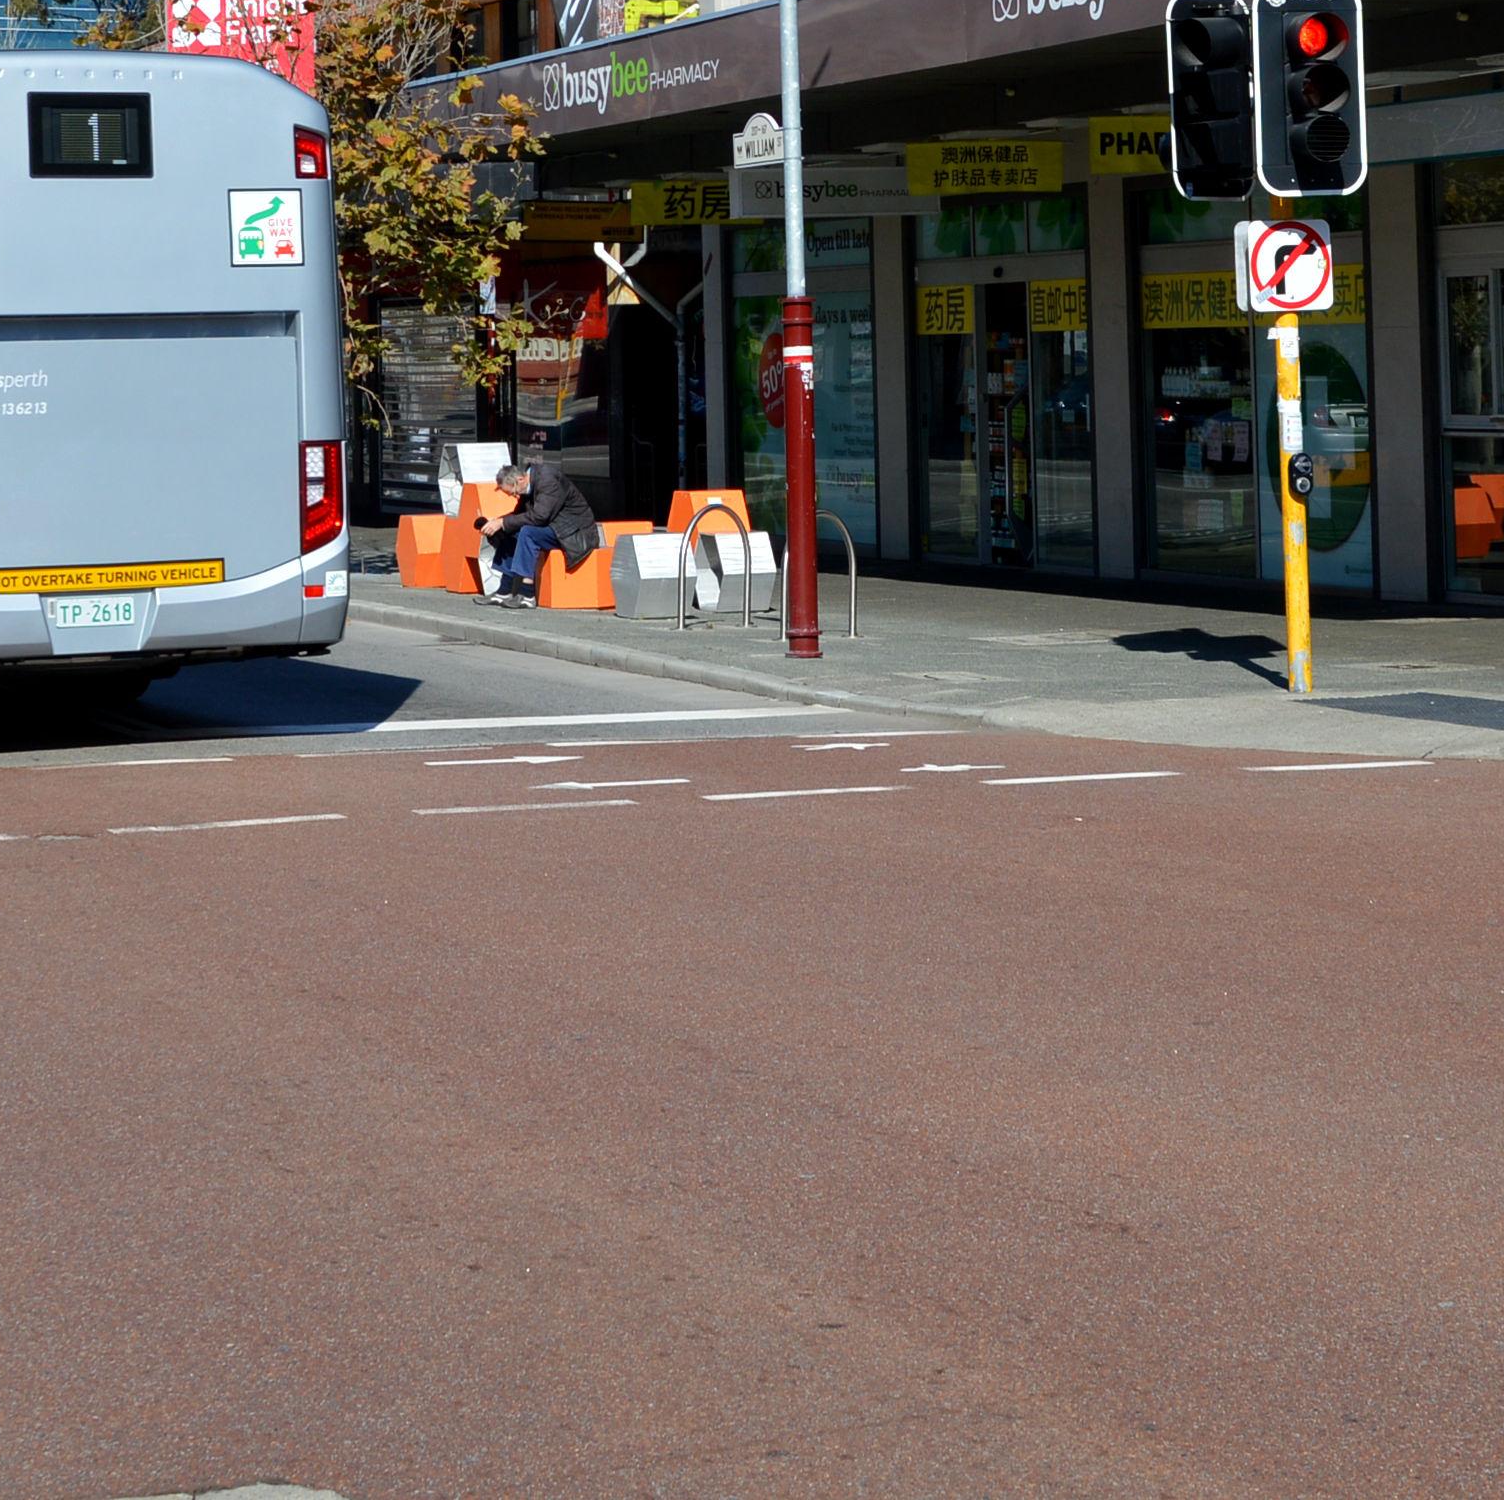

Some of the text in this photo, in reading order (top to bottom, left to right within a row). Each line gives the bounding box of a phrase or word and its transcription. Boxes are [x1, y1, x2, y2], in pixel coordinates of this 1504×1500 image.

[560, 51, 720, 115] busybee PHARMACY
[87, 113, 100, 162] 1
[745, 137, 776, 159] WILLIAM
[941, 145, 1030, 165] 澳洲保健品
[934, 167, 1039, 188] 护肤品专卖店
[663, 184, 729, 220] 药房
[775, 180, 858, 203] bsybee
[268, 218, 294, 228] GIVE
[270, 228, 294, 237] WAY
[806, 231, 832, 257] Open
[924, 287, 965, 333] 药房
[22, 573, 93, 587] OVERTAKE
[97, 570, 157, 583] TURNING
[161, 567, 217, 580] VEHICLE
[92, 602, 132, 623] 2618
